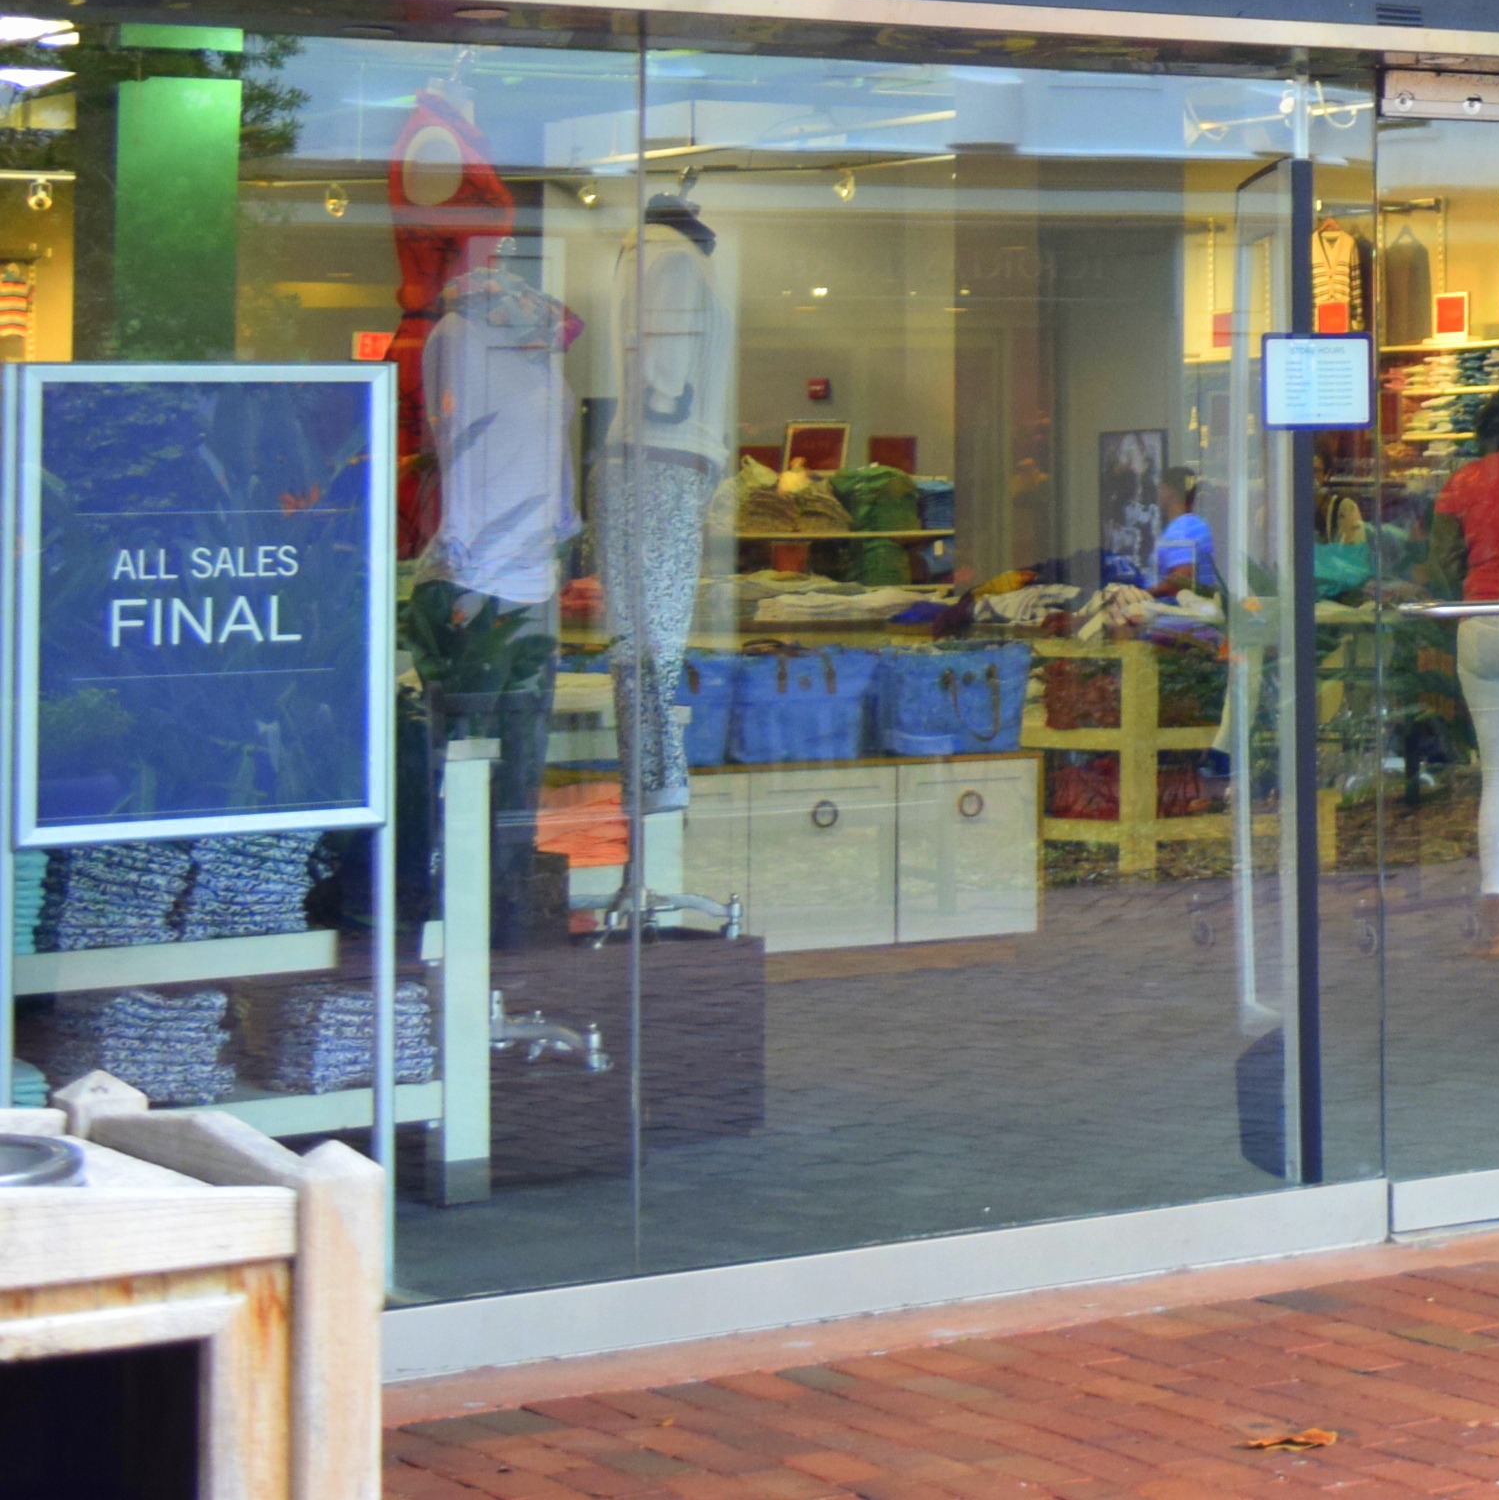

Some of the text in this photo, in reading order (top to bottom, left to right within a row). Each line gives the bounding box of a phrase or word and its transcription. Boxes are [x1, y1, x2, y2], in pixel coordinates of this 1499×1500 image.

[1317, 346, 1346, 354] HOURS
[112, 544, 299, 581] ALL SALES
[111, 594, 303, 647] FINAL
